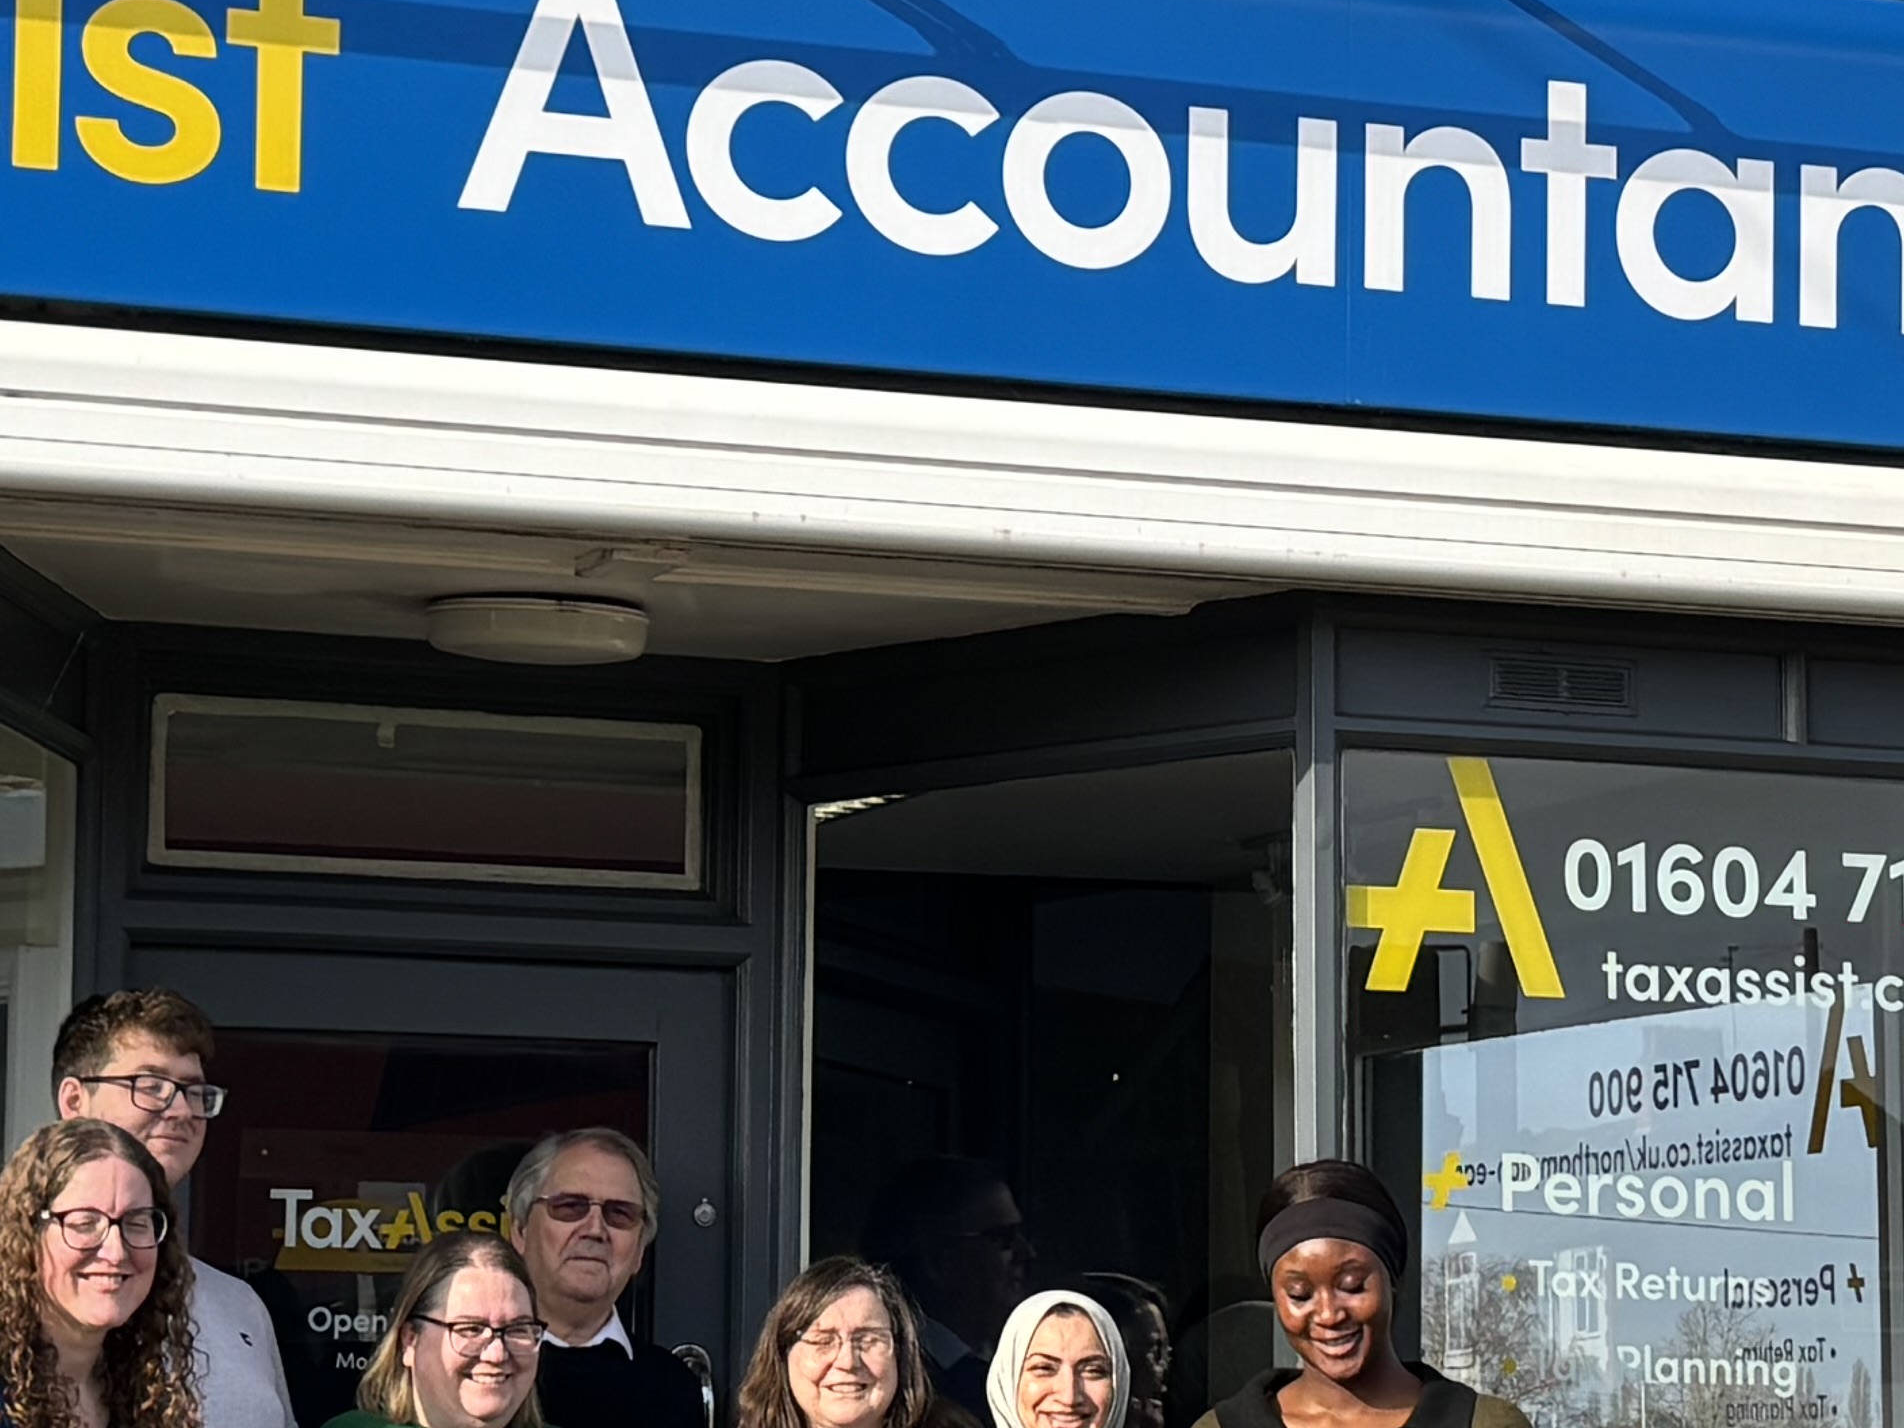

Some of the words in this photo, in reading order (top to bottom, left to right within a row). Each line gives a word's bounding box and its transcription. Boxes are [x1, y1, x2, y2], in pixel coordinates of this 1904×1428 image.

[1562, 837, 1816, 919] 01604
[1501, 1152, 1795, 1222] Personal
[1529, 1257, 1601, 1299] Tax
[1615, 1262, 1773, 1303] Returns
